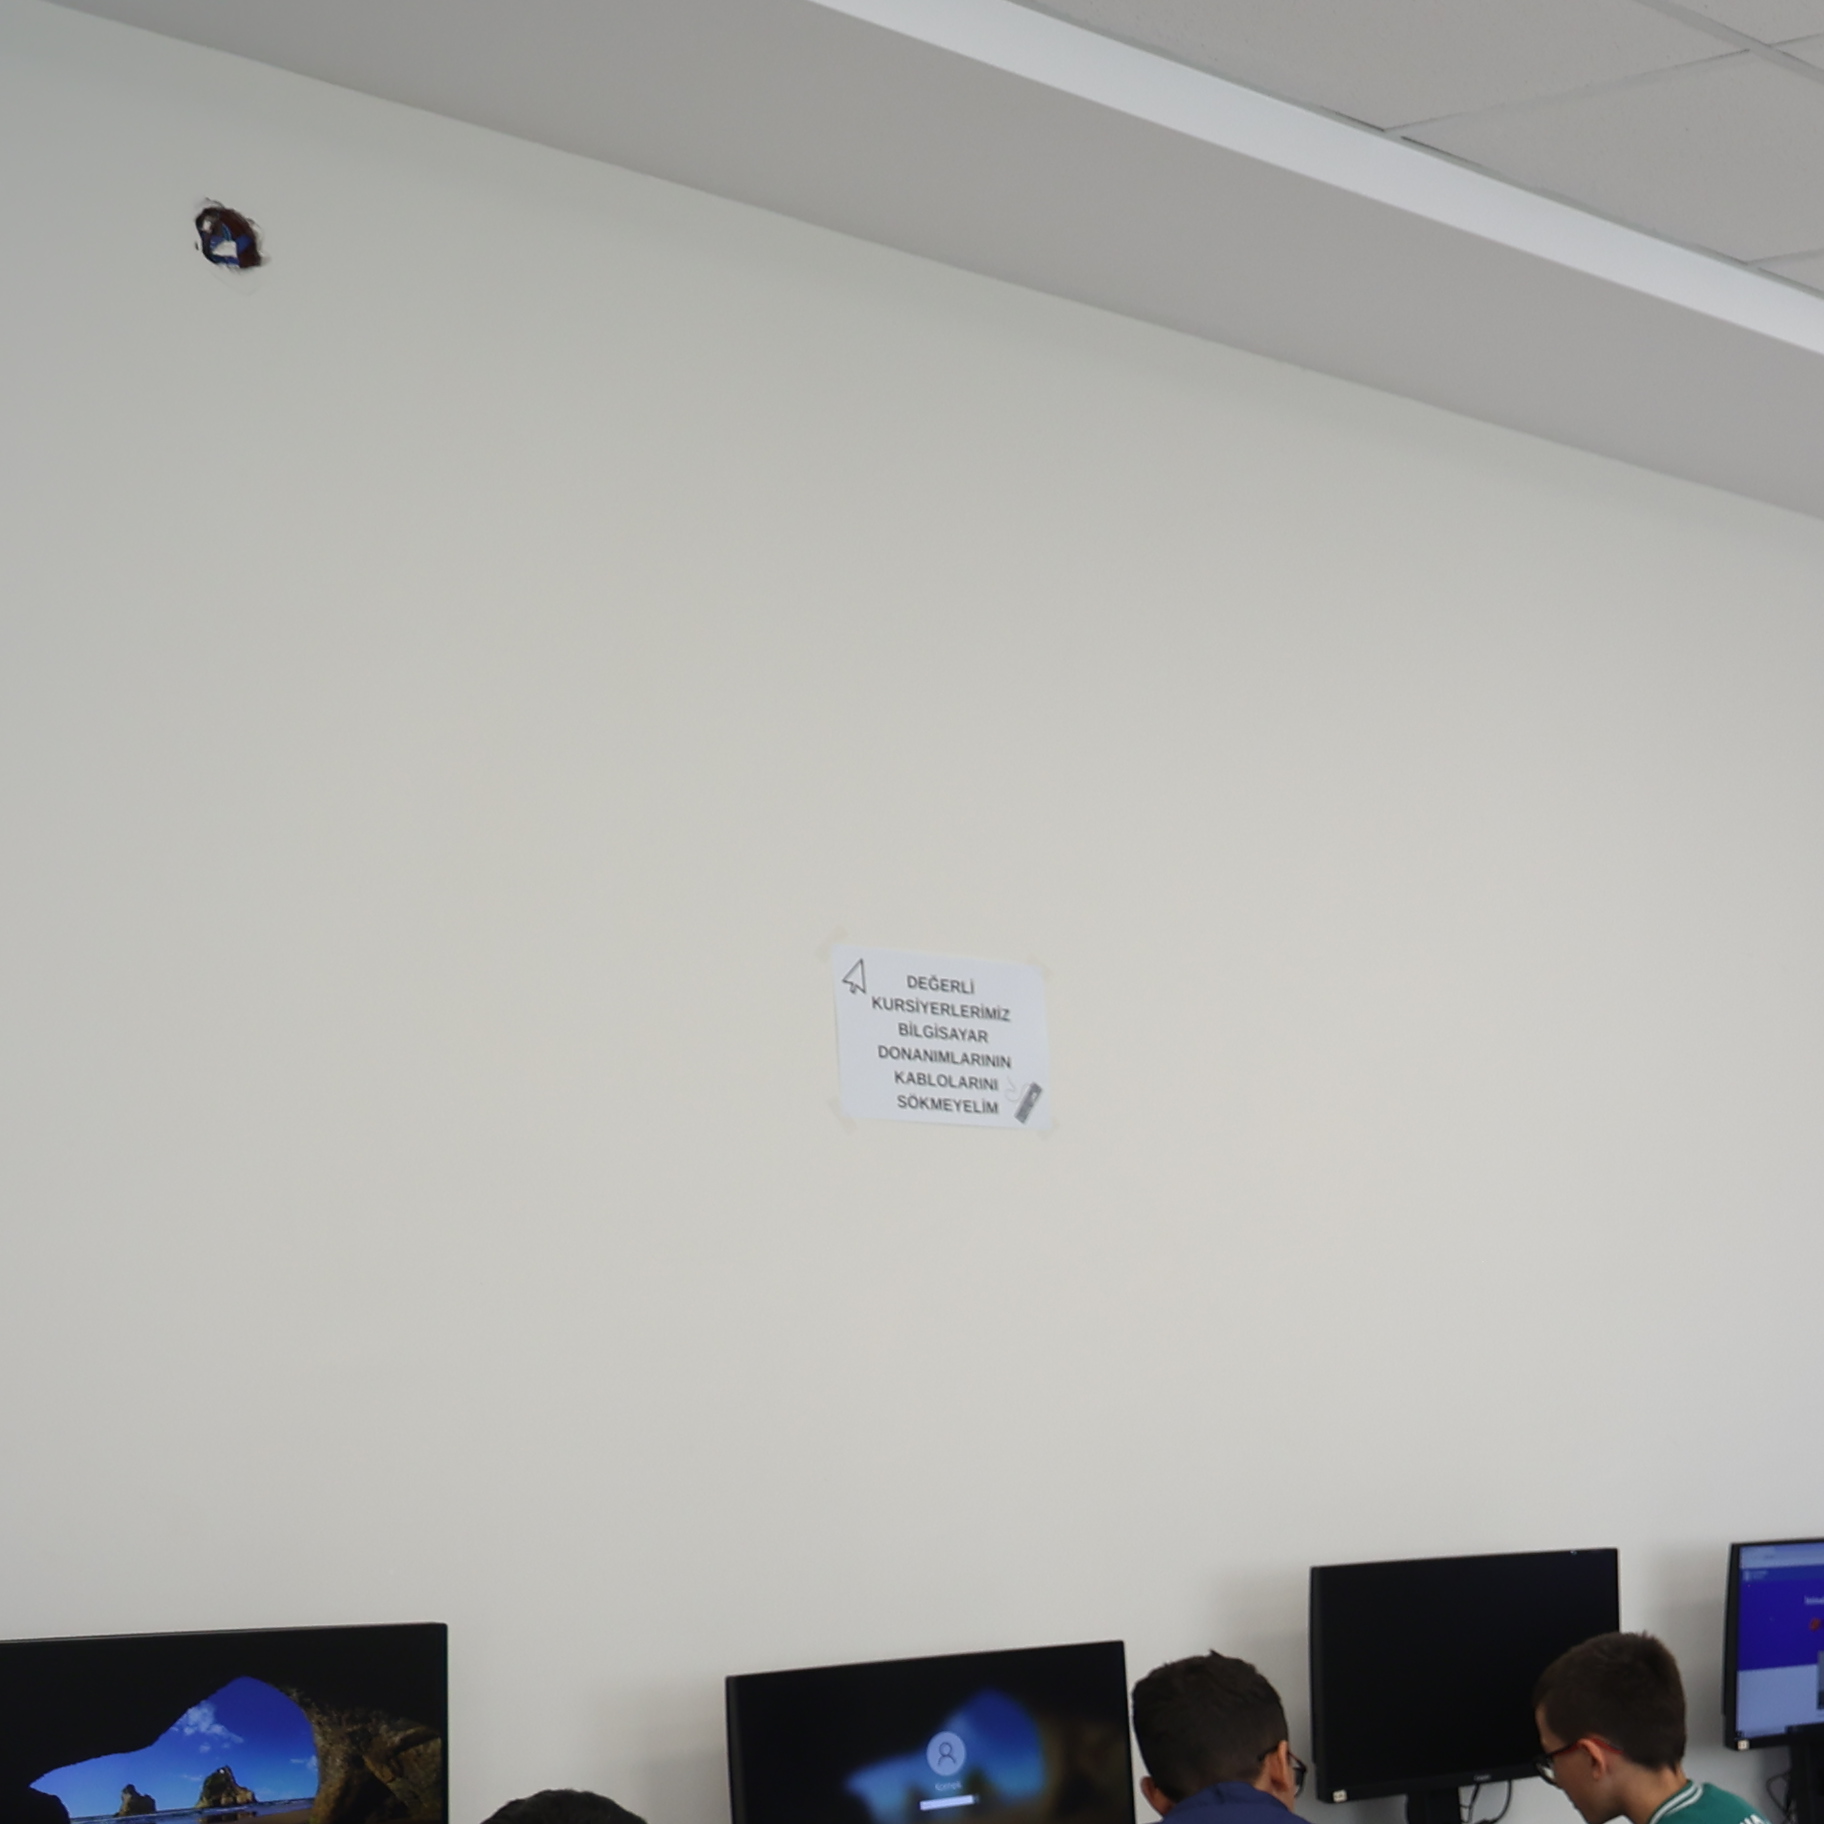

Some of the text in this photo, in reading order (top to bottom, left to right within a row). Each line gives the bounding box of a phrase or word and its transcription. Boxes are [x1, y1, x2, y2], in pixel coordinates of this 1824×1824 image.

[907, 974, 976, 995] DEĞERLİ
[871, 996, 1011, 1022] KURSİYERLERİMİZ
[898, 1022, 989, 1043] BİLGİSAYAR
[877, 1045, 1012, 1068] DONANIMLARININ
[894, 1071, 998, 1091] KABLOLARINI
[897, 1095, 999, 1114] SÖKMEYELİM
